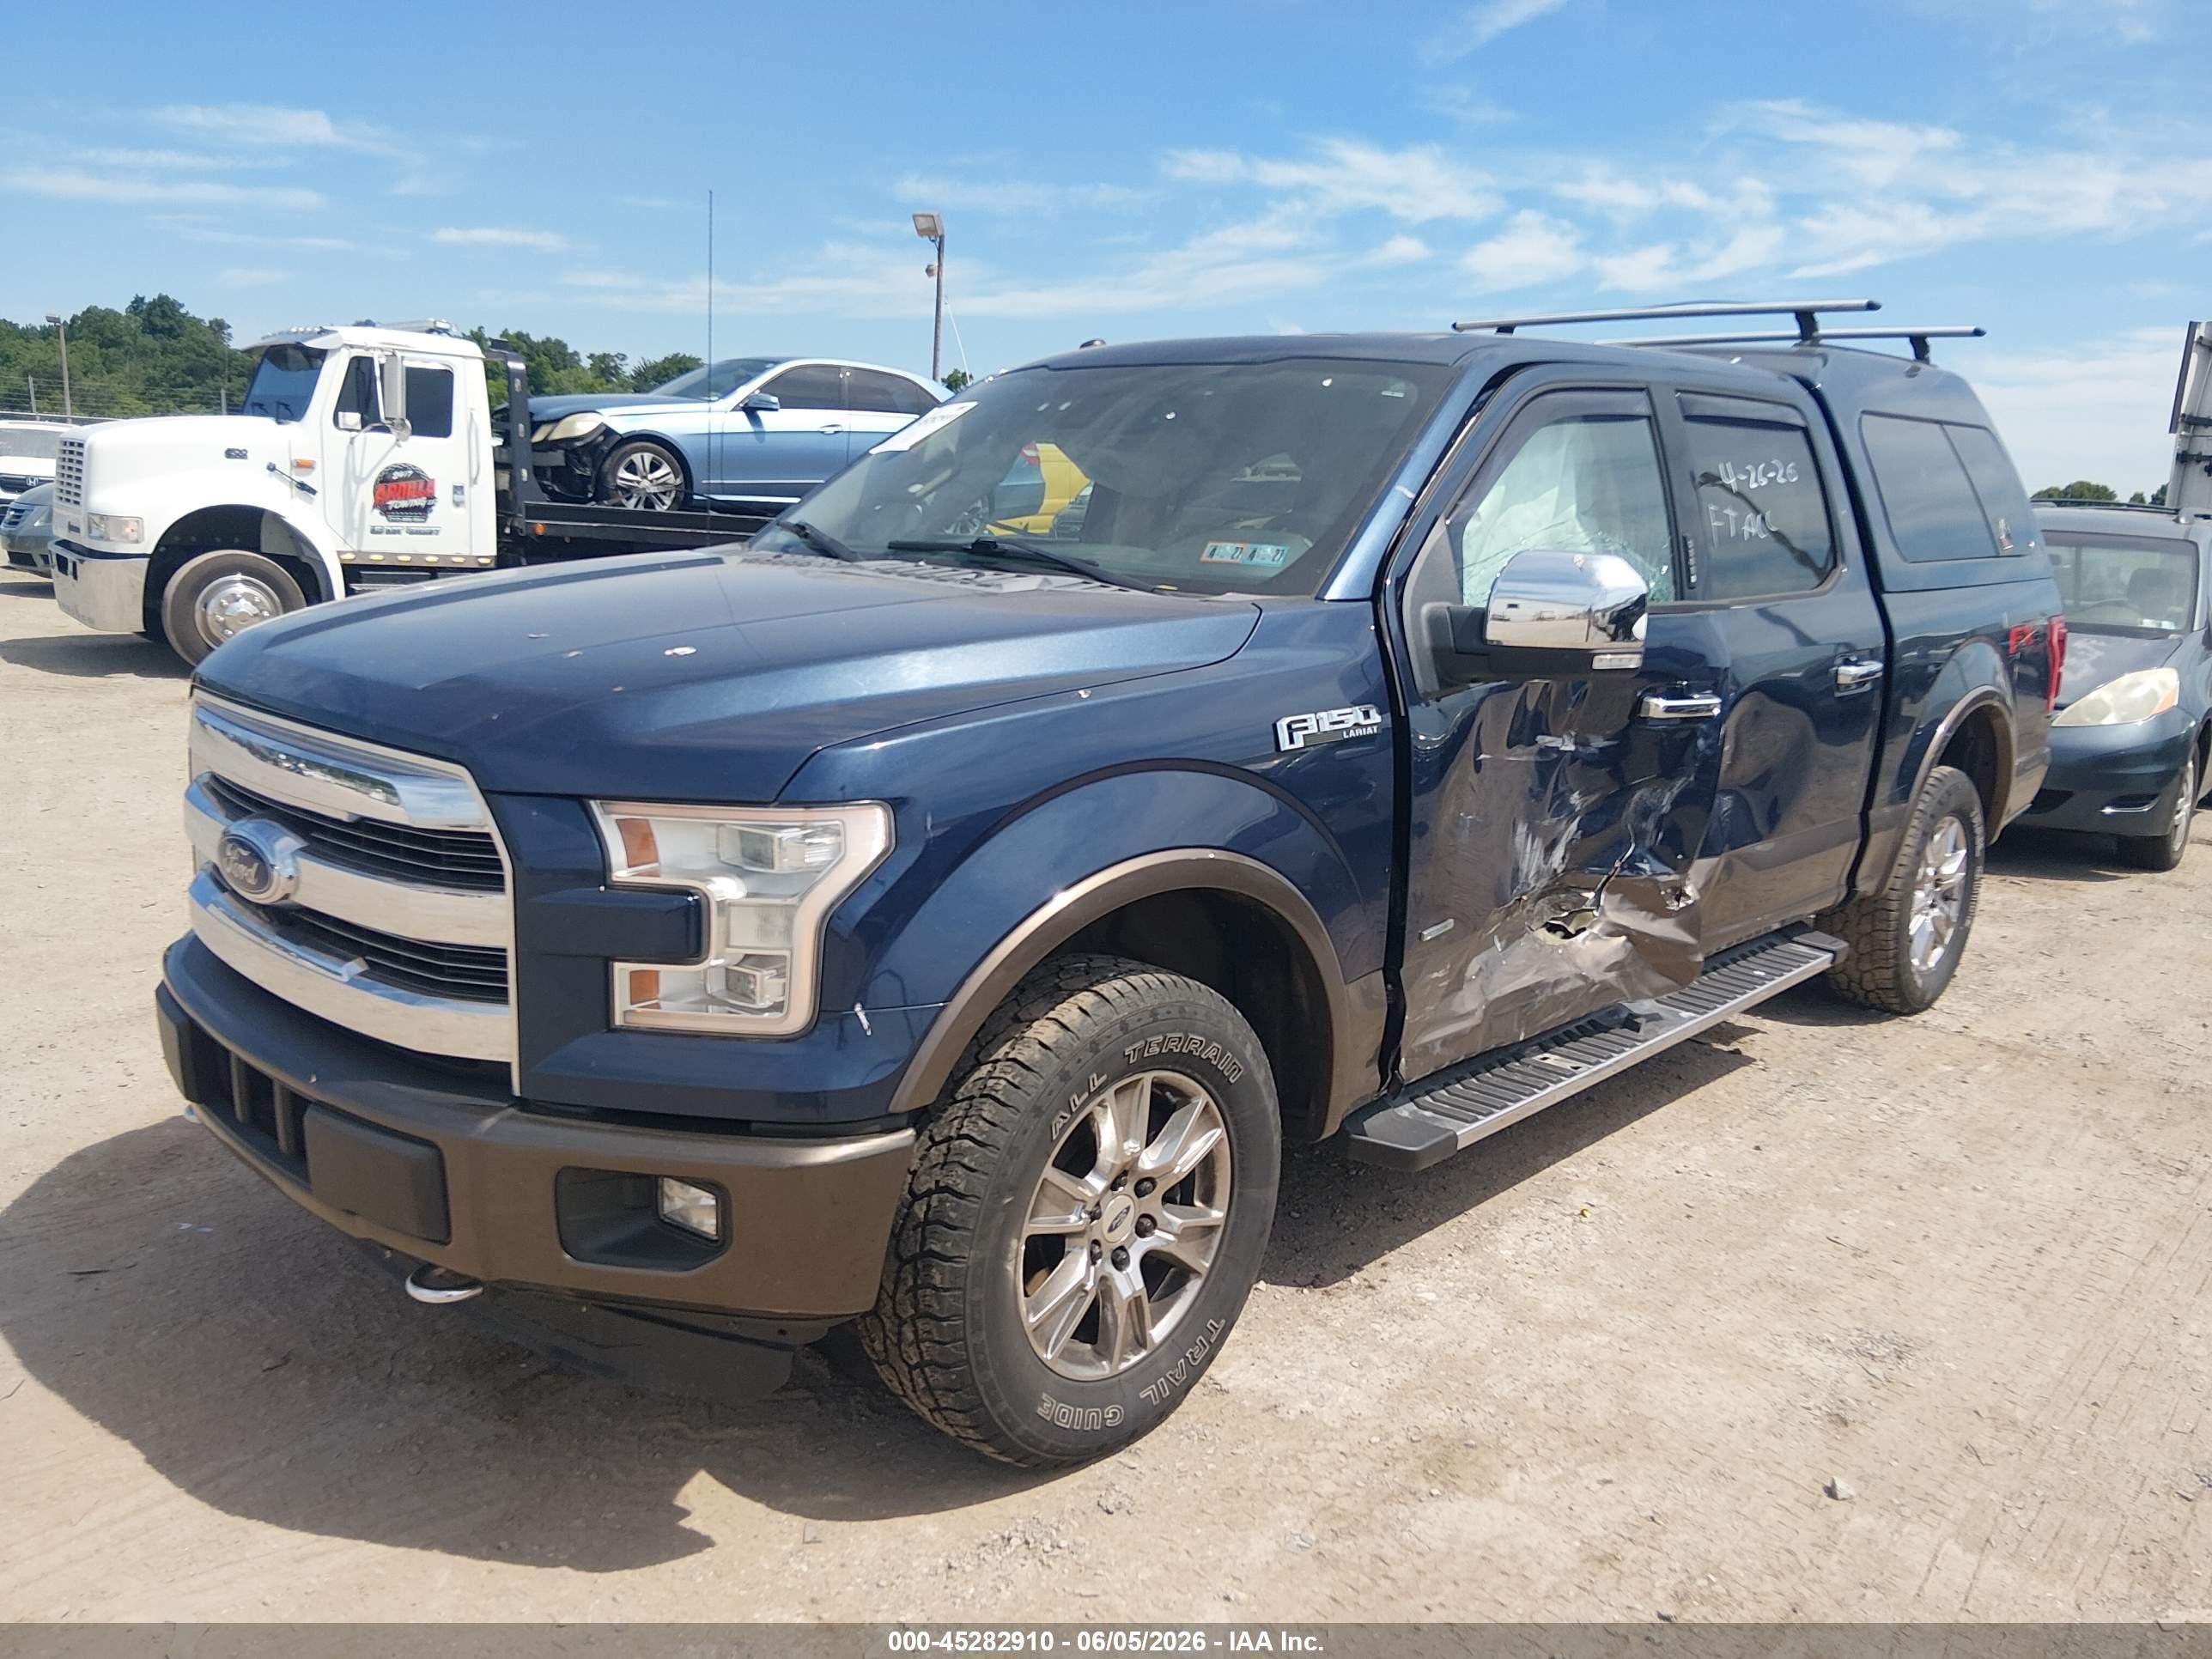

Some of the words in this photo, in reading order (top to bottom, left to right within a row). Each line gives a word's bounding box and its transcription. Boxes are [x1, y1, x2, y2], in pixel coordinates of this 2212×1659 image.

[1342, 726, 1378, 738] LARIAT
[1050, 1072, 1108, 1141] ALL
[1123, 1032, 1244, 1084] TERRAIN
[1139, 1317, 1226, 1407] TRAIL
[1036, 1392, 1125, 1431] GUIDE
